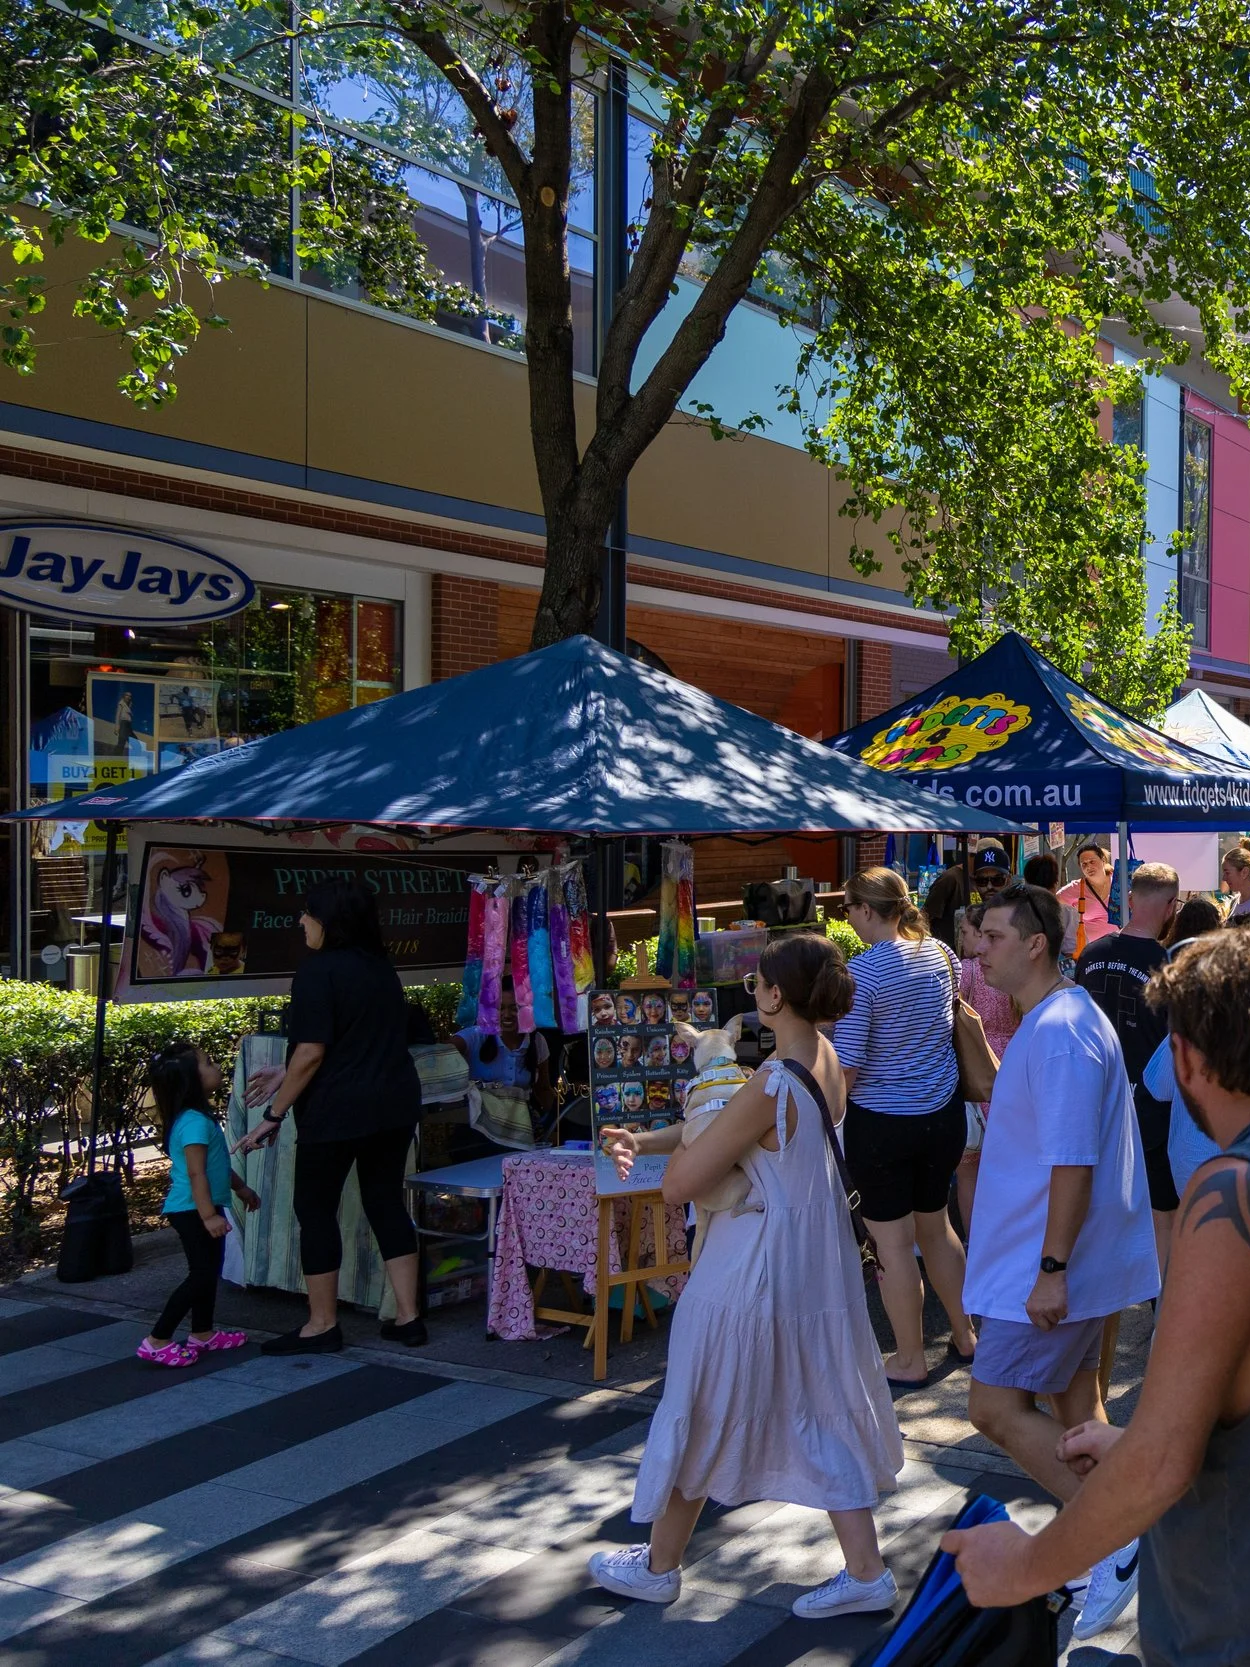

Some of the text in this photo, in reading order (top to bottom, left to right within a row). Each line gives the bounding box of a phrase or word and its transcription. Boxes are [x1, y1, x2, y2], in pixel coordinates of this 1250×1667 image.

[885, 705, 1018, 743] FIDGETS
[879, 744, 968, 765] KIDS
[62, 766, 89, 778] BUY
[101, 766, 127, 779] GET
[364, 869, 467, 895] STREET
[251, 907, 468, 929] Face Hair Braidi
[1084, 961, 1106, 975] DARKEST
[1107, 961, 1127, 972] BEFORE
